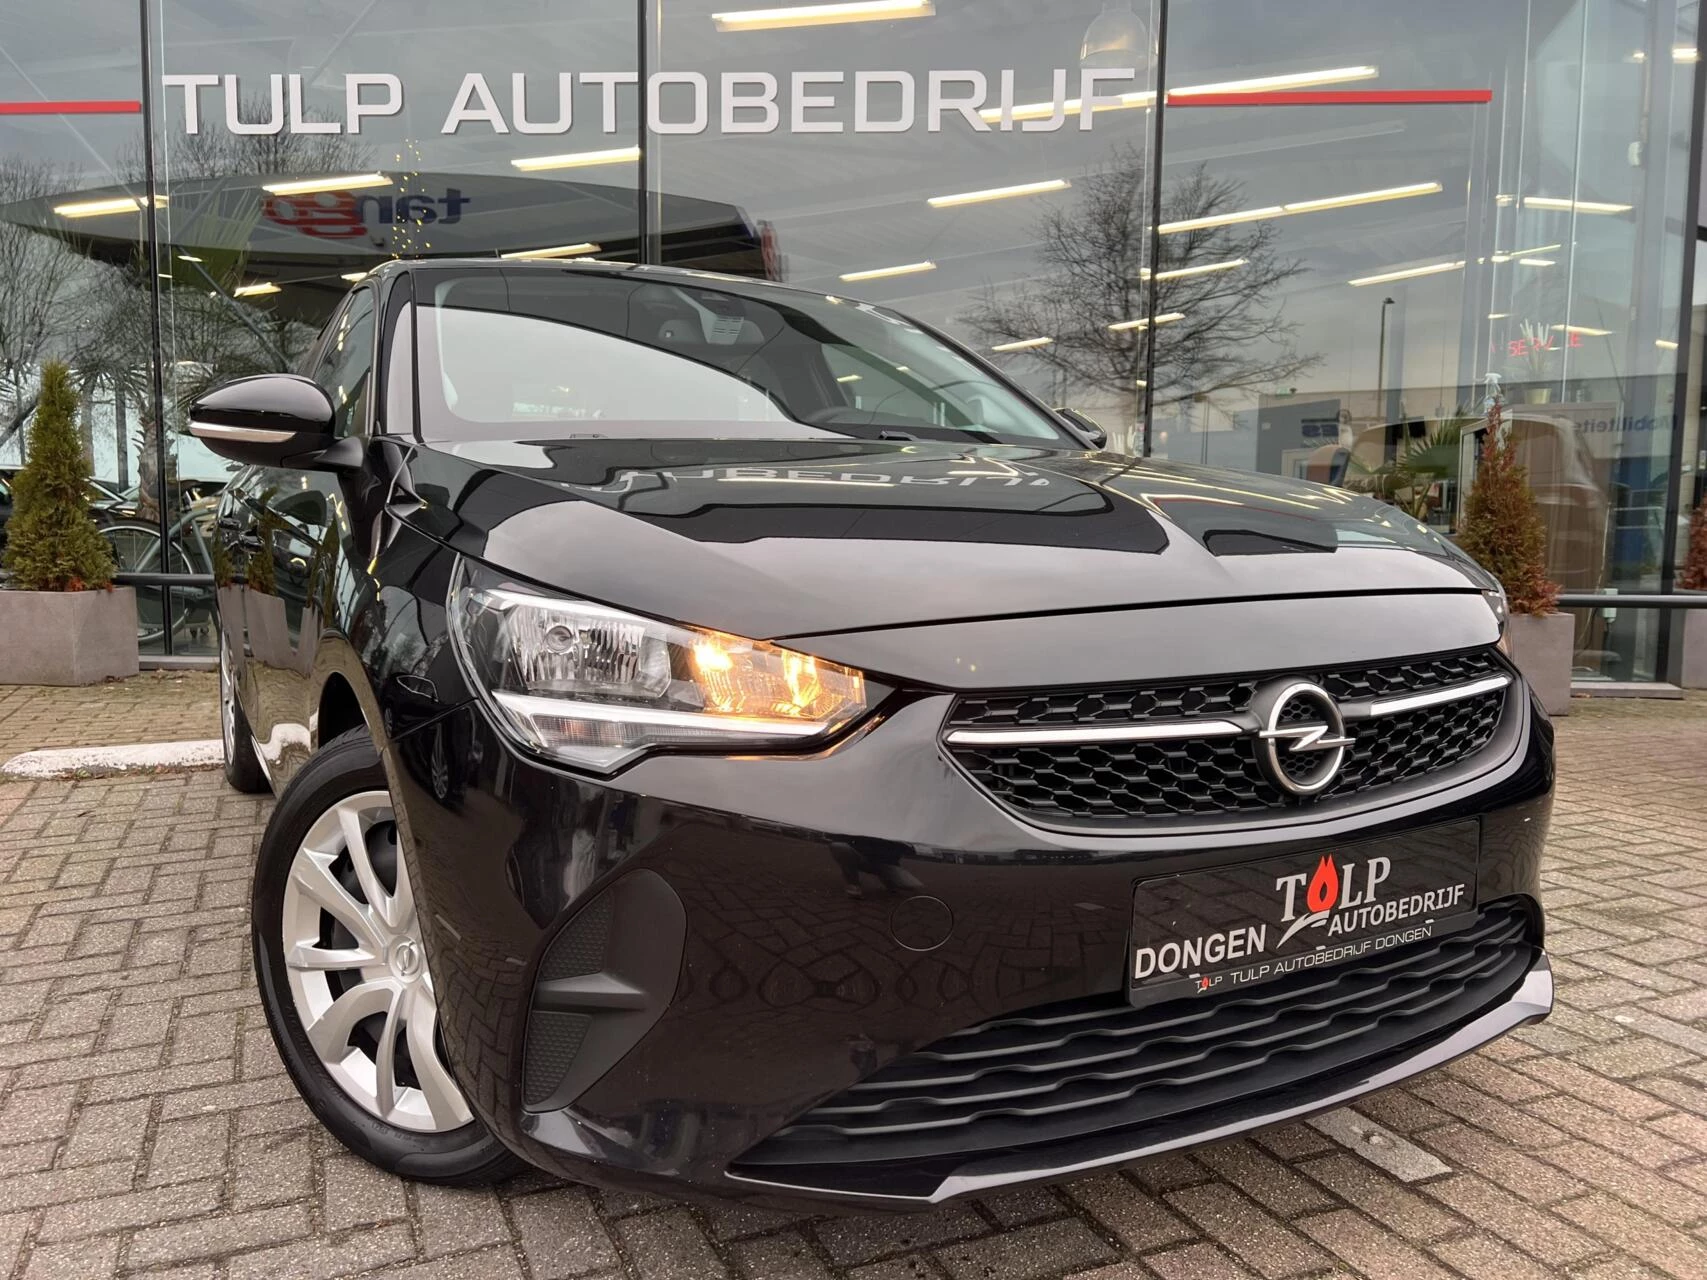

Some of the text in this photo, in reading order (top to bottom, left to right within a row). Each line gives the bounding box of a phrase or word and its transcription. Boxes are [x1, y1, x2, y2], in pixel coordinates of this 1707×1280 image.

[162, 67, 1136, 135] TULP AUTOBEDRIJF
[1507, 331, 1584, 357] SERVE
[1327, 883, 1465, 937] AUTOBEDRIJF
[1134, 923, 1267, 980] DONGEN
[1231, 965, 1270, 985] TULP
[1273, 939, 1372, 976] AUTOBEDRIJF
[1375, 925, 1433, 951] DONGEN
